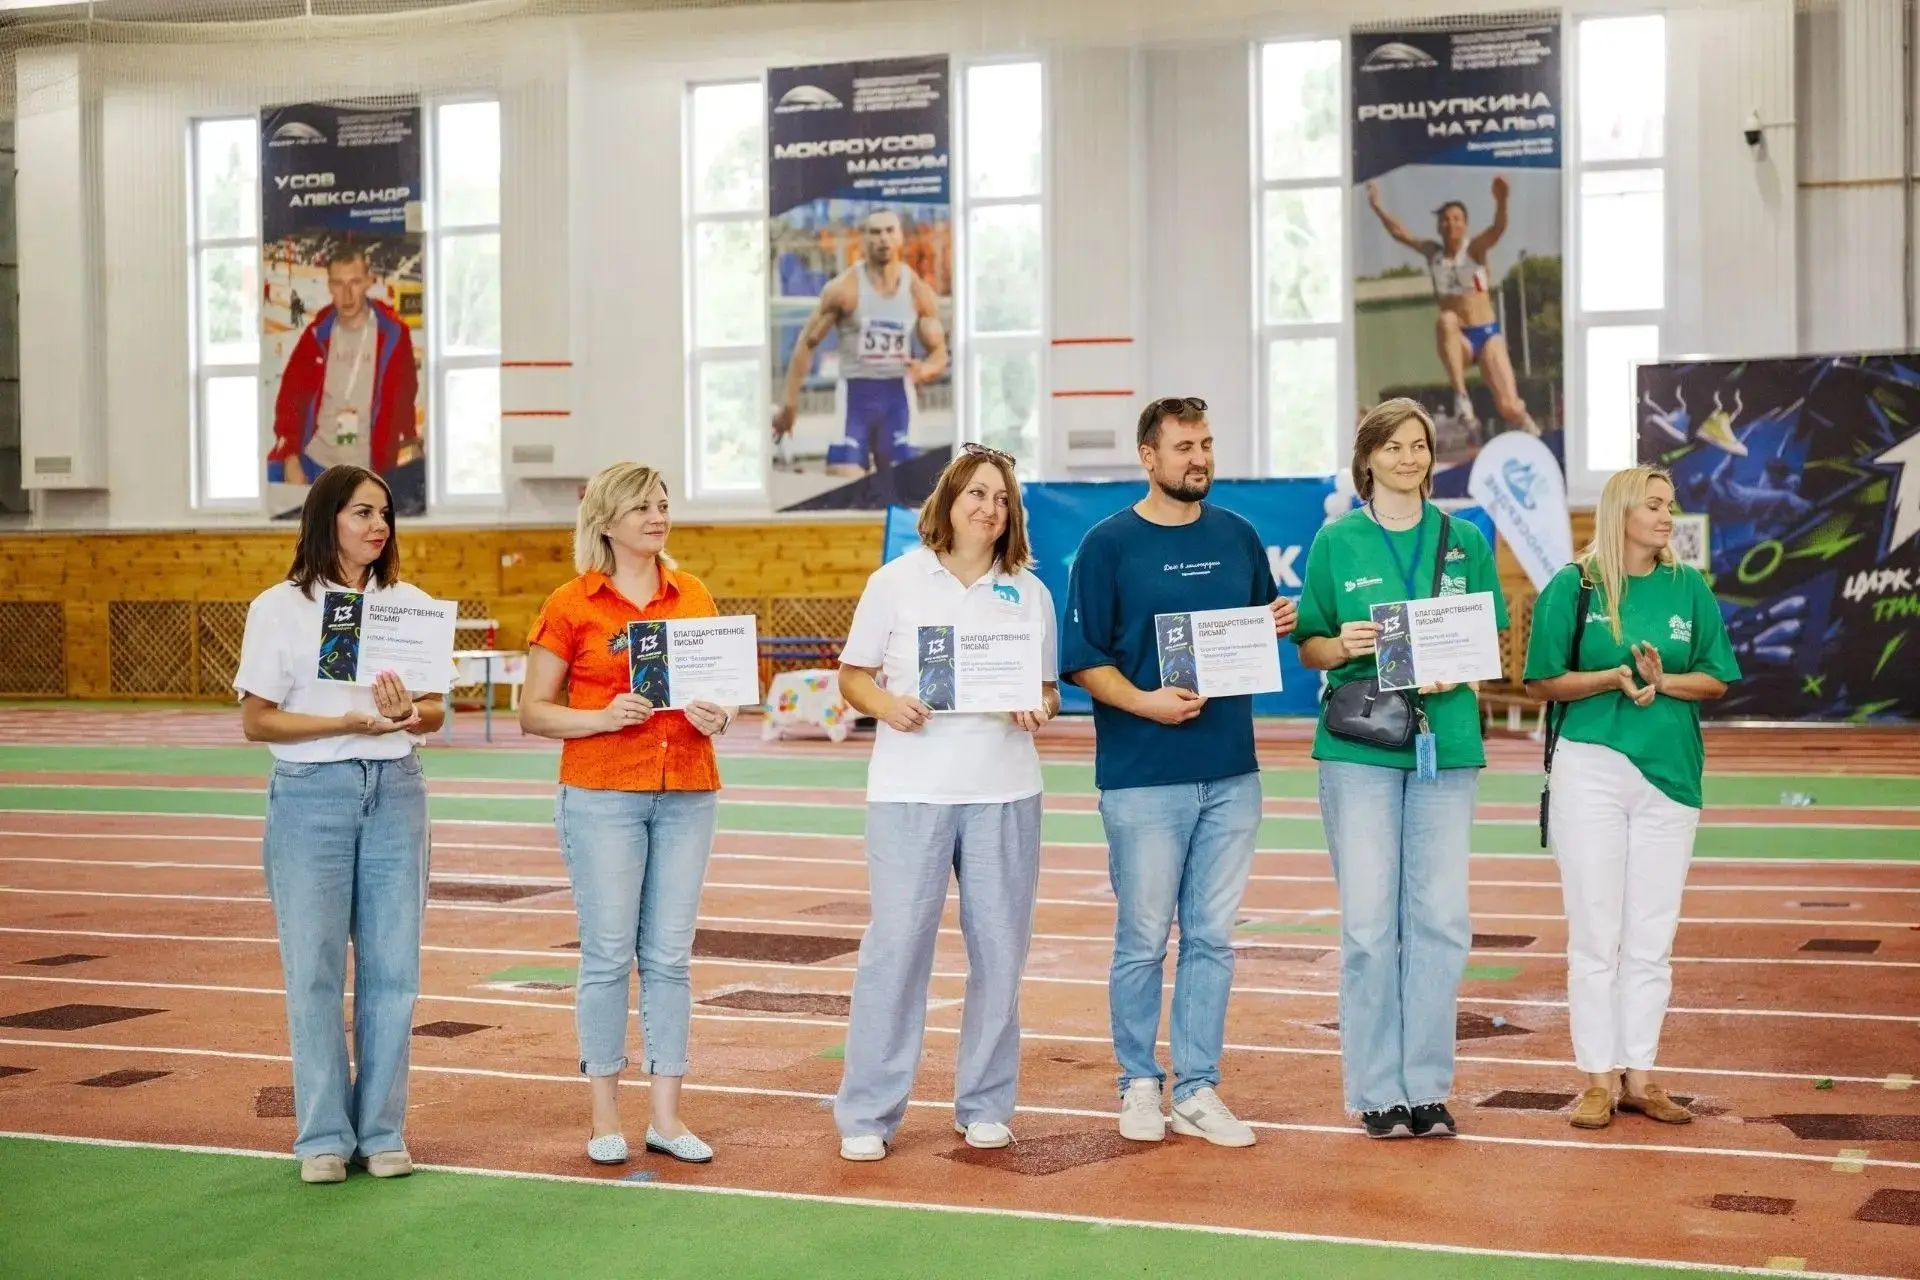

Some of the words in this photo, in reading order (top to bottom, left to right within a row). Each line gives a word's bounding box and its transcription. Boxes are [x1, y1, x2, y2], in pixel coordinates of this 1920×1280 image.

[1358, 92, 1551, 121] РОЩУПКИНА
[1427, 114, 1555, 137] НАТАЛЬЯ
[774, 134, 936, 159] МОКРОУСОВ
[847, 154, 948, 174] МАКСИМ
[274, 172, 335, 189] УСОВ
[289, 187, 410, 208] АЛЕКСАНДР
[333, 605, 353, 622] 13
[369, 614, 400, 623] ПИСЬМО
[370, 604, 445, 619] БЛАГОДАРСТВЕННОЕ
[1414, 604, 1483, 618] БЛАГОДАРСТВЕННОЕ
[1198, 617, 1265, 629] БЛАГОДАРСТВЕННОЕ
[1382, 615, 1401, 633] 13
[1416, 617, 1444, 626] ПИСЬМО
[674, 627, 745, 638] БЛАГОДАРСТВЕННОЕ
[960, 634, 1031, 643] БЛАГОДАРСТВЕННОЕ
[1166, 626, 1184, 643] 13
[1198, 629, 1227, 637] ПИСЬМО
[640, 634, 659, 652] 13
[674, 638, 704, 647] ПИСЬМО
[927, 638, 946, 654] 13
[960, 643, 990, 651] ПИСЬМО
